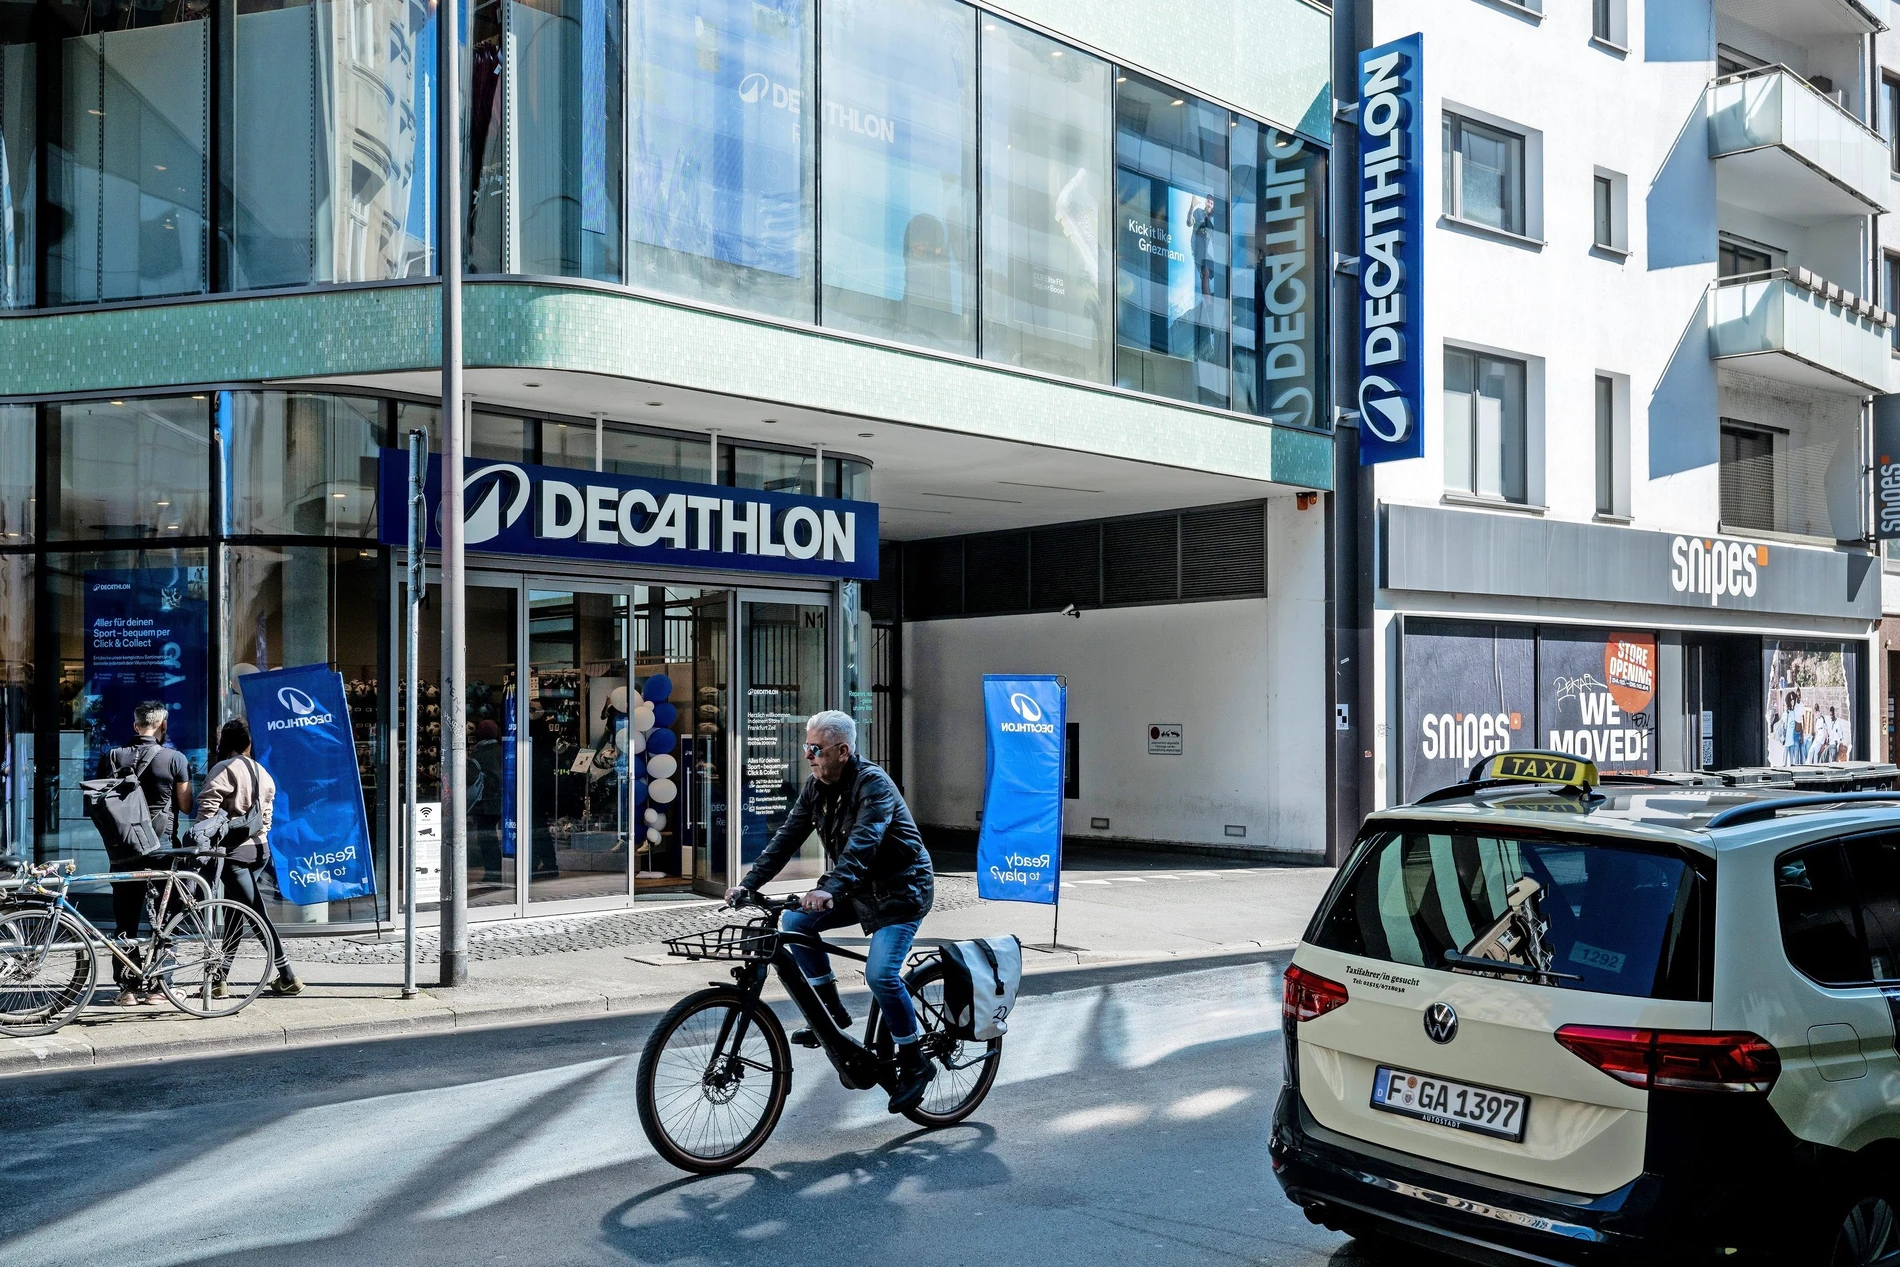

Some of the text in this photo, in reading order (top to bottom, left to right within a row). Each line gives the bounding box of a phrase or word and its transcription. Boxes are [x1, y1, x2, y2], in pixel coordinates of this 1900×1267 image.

[772, 82, 895, 144] DETHLON
[1364, 51, 1406, 366] DECATHLON
[1128, 219, 1172, 243] Kick it like
[1138, 238, 1185, 262] Griezmann
[1050, 284, 1066, 295] Boost
[1056, 278, 1064, 287] FG
[541, 479, 855, 563] DECATHLON
[1672, 536, 1758, 606] snipes
[93, 618, 154, 627] Alles für deinen
[805, 611, 825, 628] N1
[93, 629, 116, 638] Sport
[122, 628, 156, 638] bequem
[157, 629, 171, 638] per
[93, 639, 152, 648] Click & Collect
[1617, 640, 1648, 667] STORE
[1609, 657, 1652, 684] OPENING
[1579, 692, 1621, 725] WE
[1422, 713, 1510, 768] snipes
[1550, 729, 1648, 762] MOVED!
[1512, 758, 1567, 779] TAXI
[1583, 948, 1620, 968] 1292
[1345, 965, 1420, 987] Taxifahrer/in gesucht
[1377, 1074, 1520, 1128] D F GA 1397
[1422, 1114, 1462, 1129] AUTOSTADT
